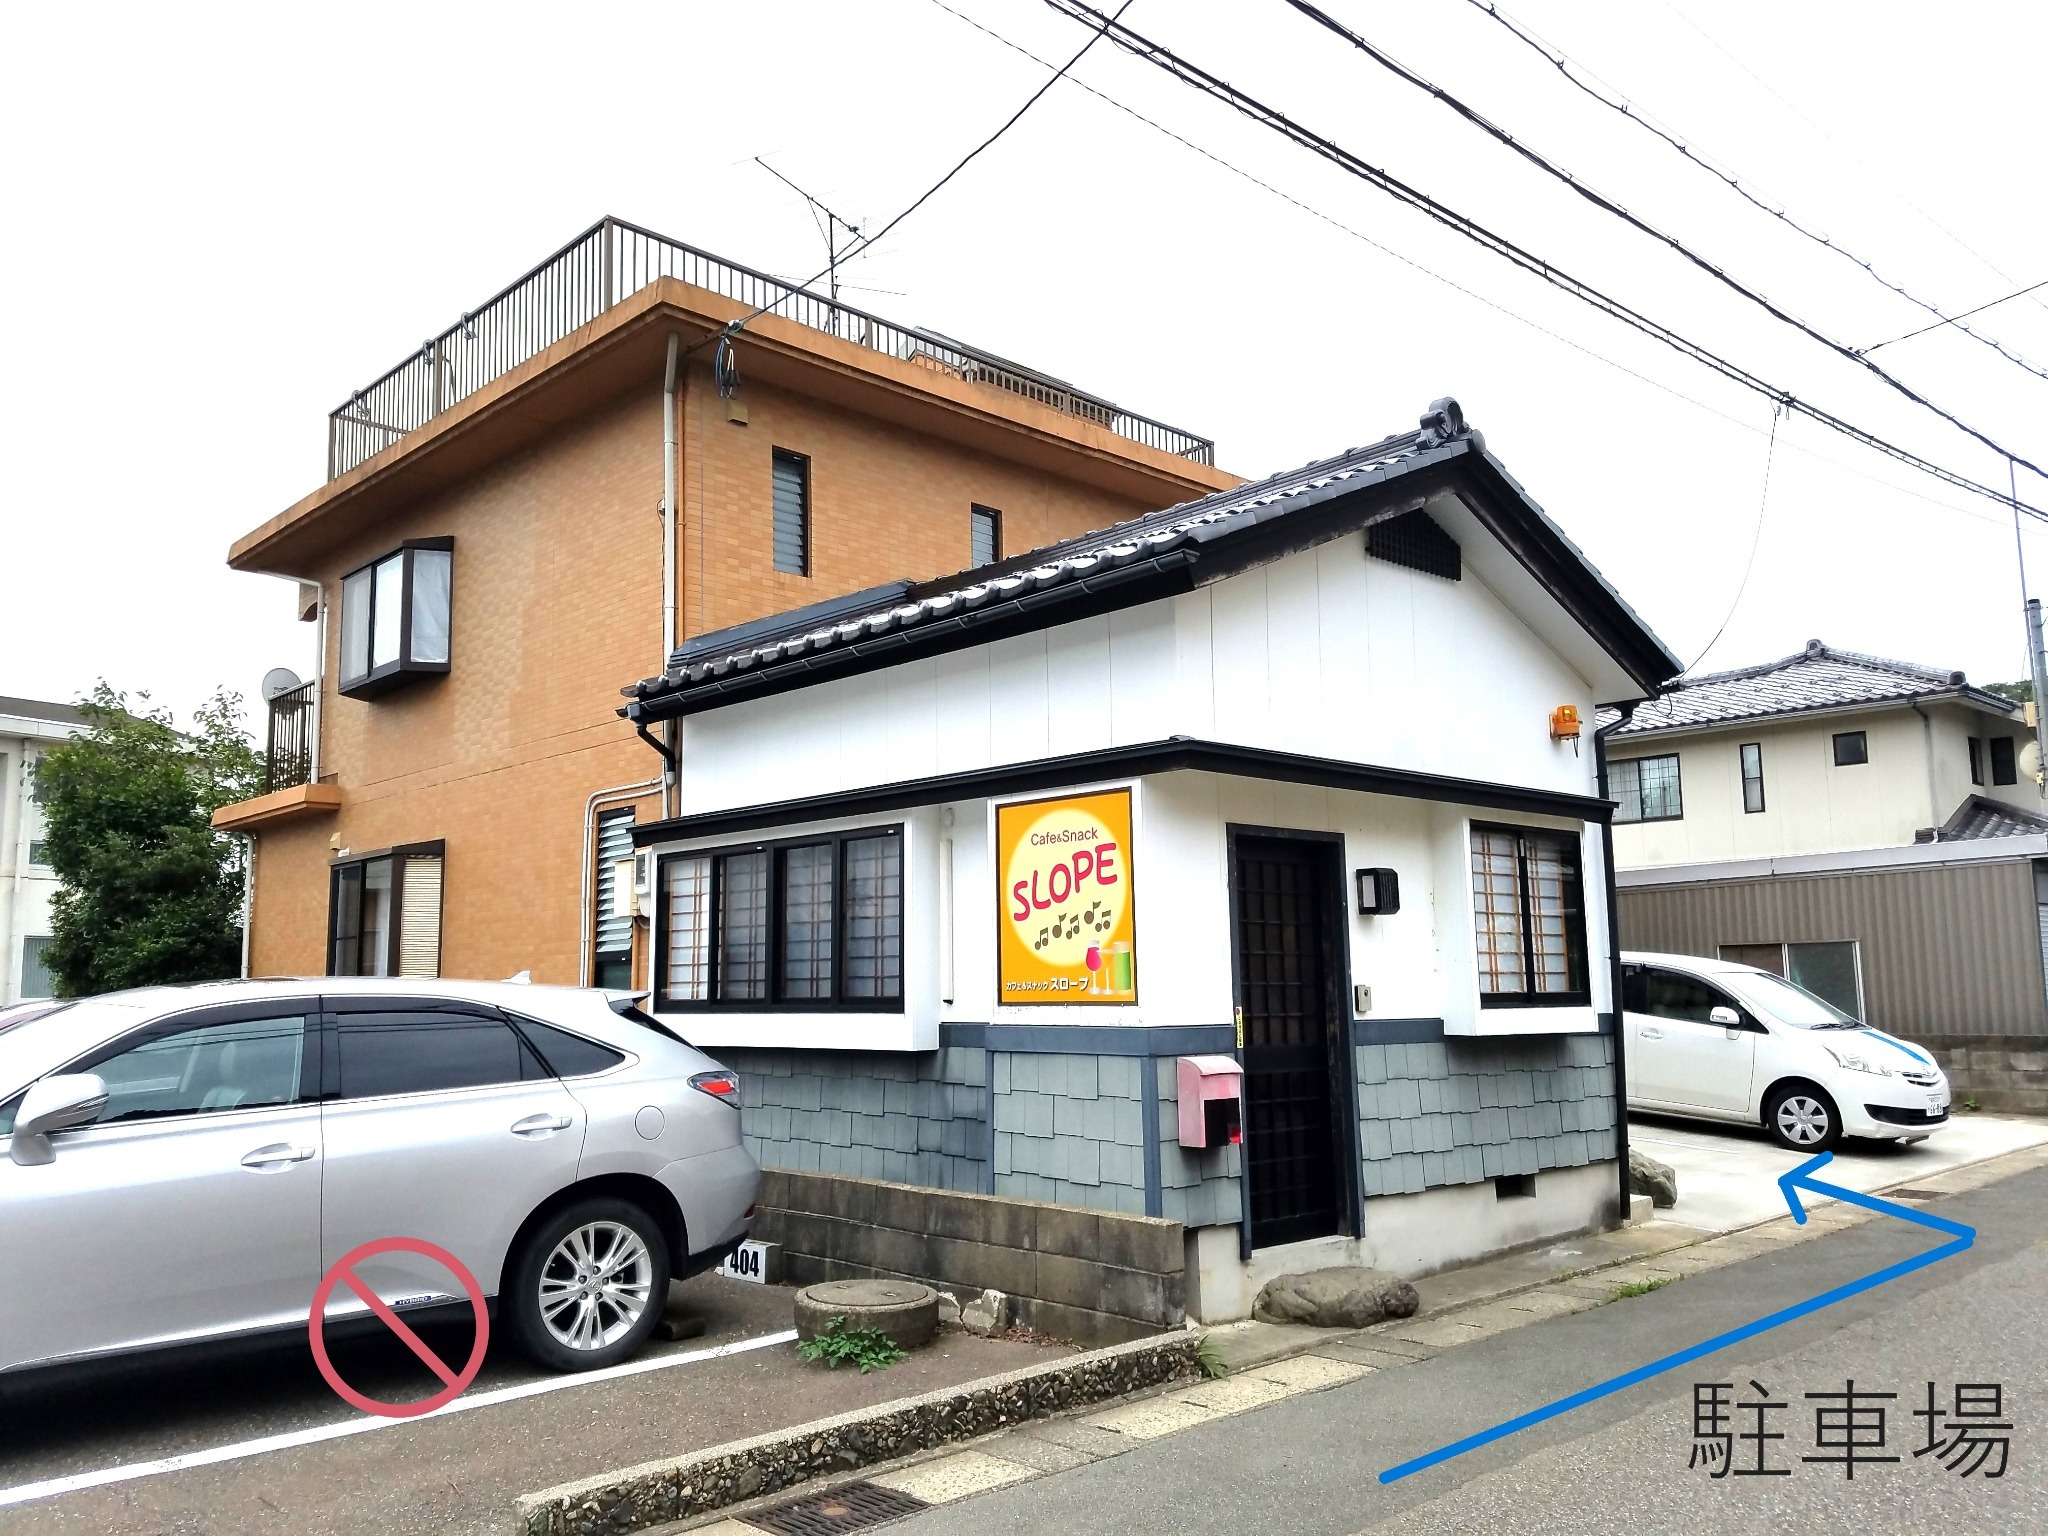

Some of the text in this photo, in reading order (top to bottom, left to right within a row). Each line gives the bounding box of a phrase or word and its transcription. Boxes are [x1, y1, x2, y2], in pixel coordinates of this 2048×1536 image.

[1031, 827, 1098, 846] Cafe&Snack
[1013, 843, 1118, 922] SLOPE
[730, 1249, 759, 1277] 404
